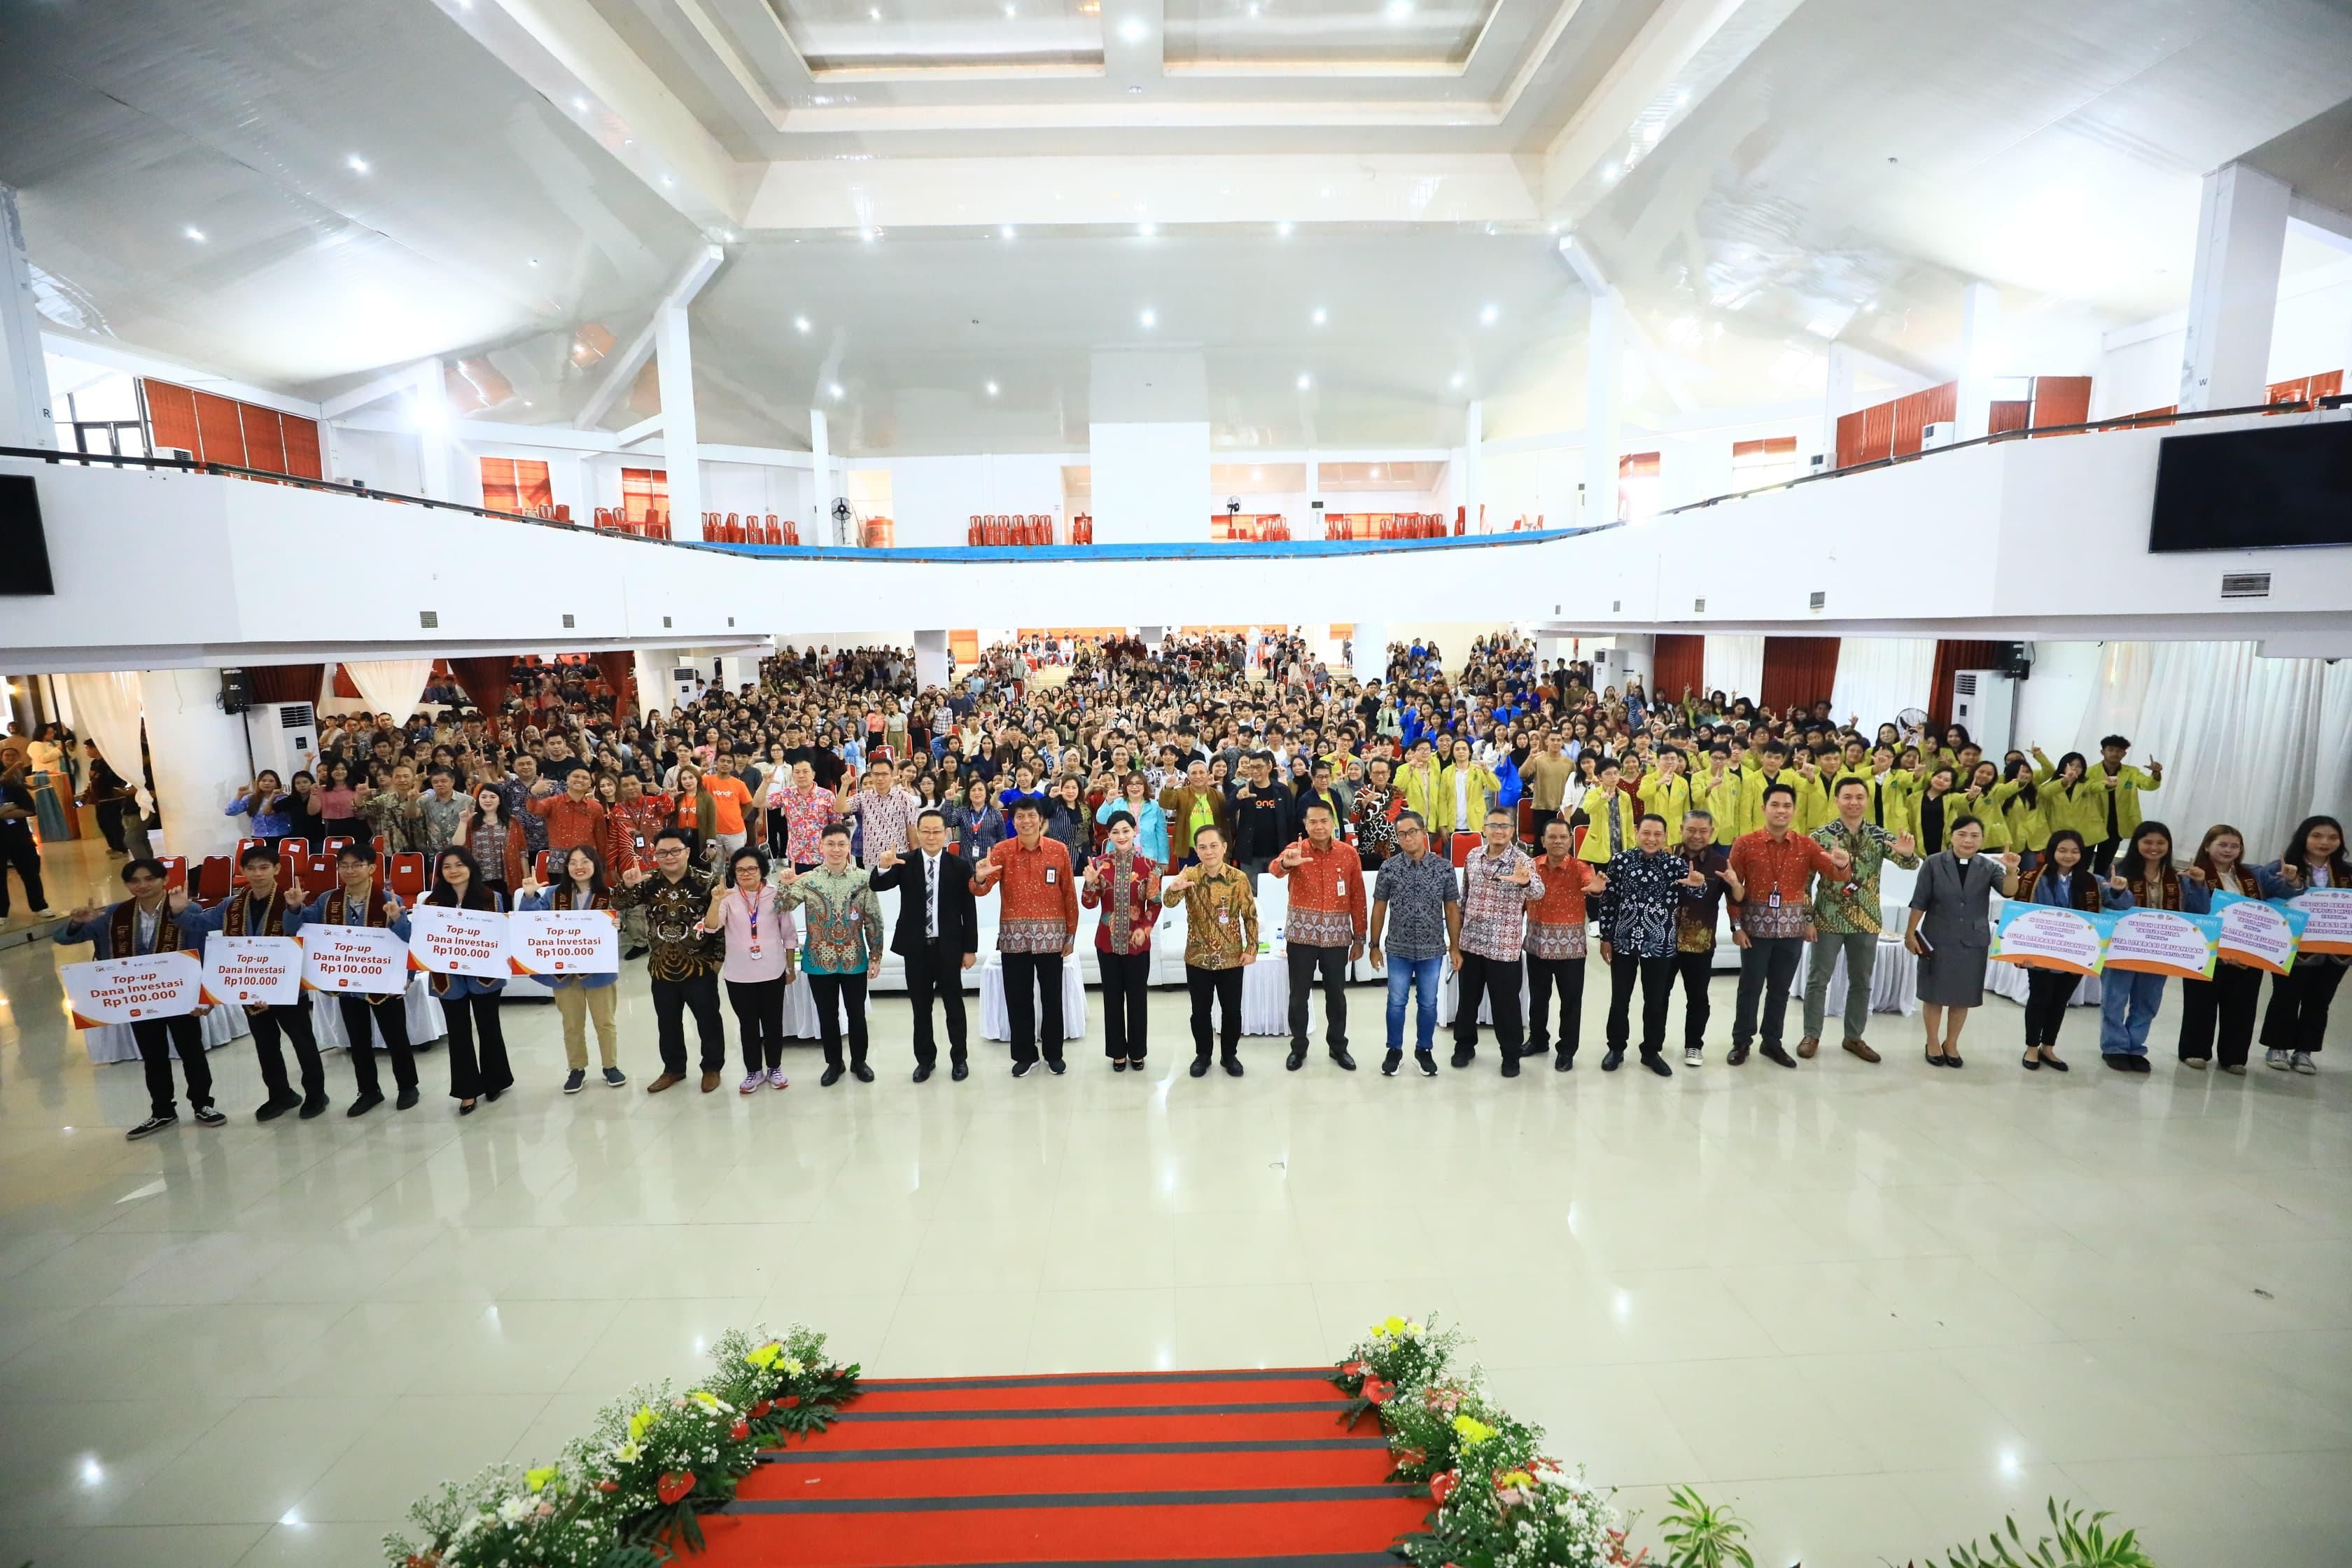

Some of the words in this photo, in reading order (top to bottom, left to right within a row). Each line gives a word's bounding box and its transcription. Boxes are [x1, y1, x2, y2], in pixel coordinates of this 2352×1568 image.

[43, 408, 51, 419] R
[447, 925, 480, 937] Top-up
[545, 927, 581, 936] Top-up
[427, 934, 452, 944] Dana
[455, 937, 498, 948] Investasi
[557, 937, 601, 946] Investasi
[334, 942, 372, 953] Top-up
[433, 945, 490, 958] Rp100.000
[536, 947, 594, 958] Rp100.000
[237, 954, 269, 964] Top-up
[313, 952, 341, 962] Dana
[344, 954, 391, 964] Investasi
[218, 965, 242, 974] Dana
[245, 965, 286, 974] Investasi
[321, 963, 382, 975] Rp100.000
[112, 972, 157, 985] Top-up
[224, 976, 278, 987] Rp100.000
[90, 988, 125, 998] Dana
[128, 979, 183, 993] Investasi
[103, 990, 176, 1008] Rp100.000
